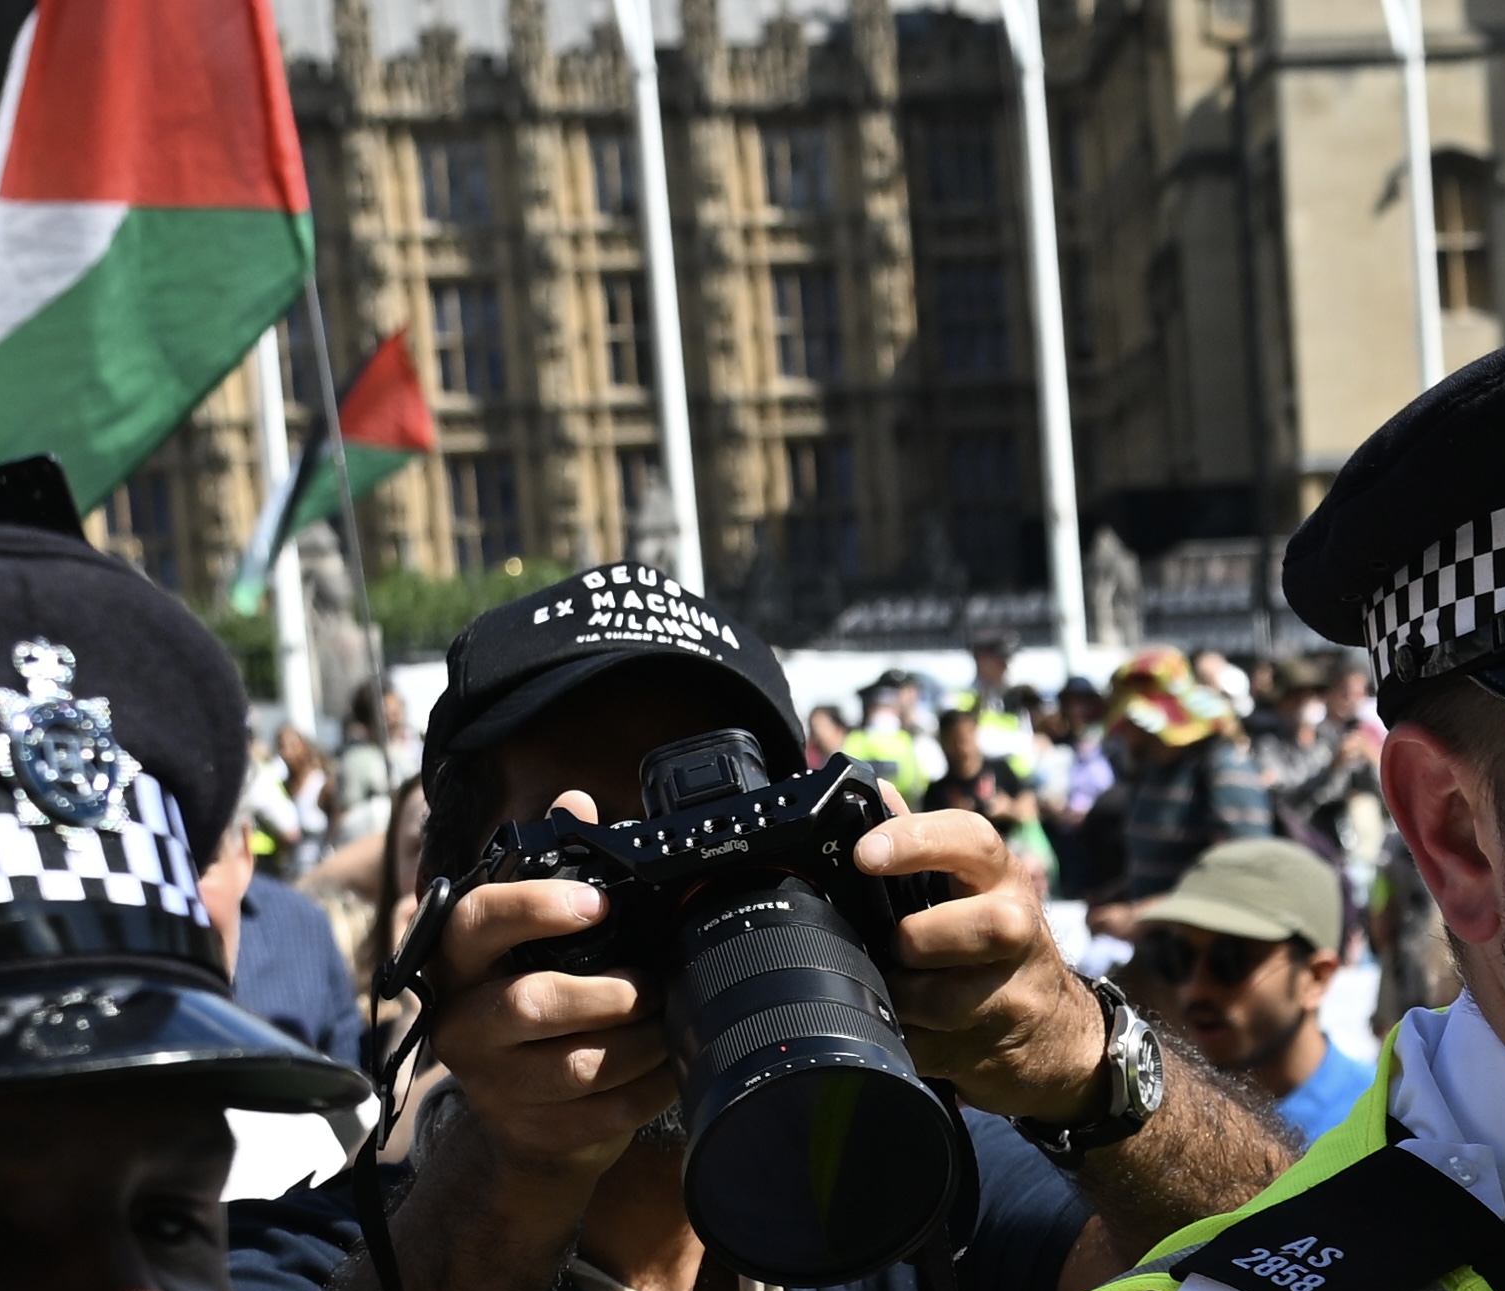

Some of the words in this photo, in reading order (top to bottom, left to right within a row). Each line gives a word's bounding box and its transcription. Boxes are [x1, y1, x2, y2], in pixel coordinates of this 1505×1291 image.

[582, 565, 682, 598] DEUS
[533, 598, 574, 625] EX
[591, 589, 741, 650] MACHINA
[587, 611, 702, 641] MILANO
[700, 839, 749, 859] SmallRig
[1278, 1236, 1345, 1268] AS
